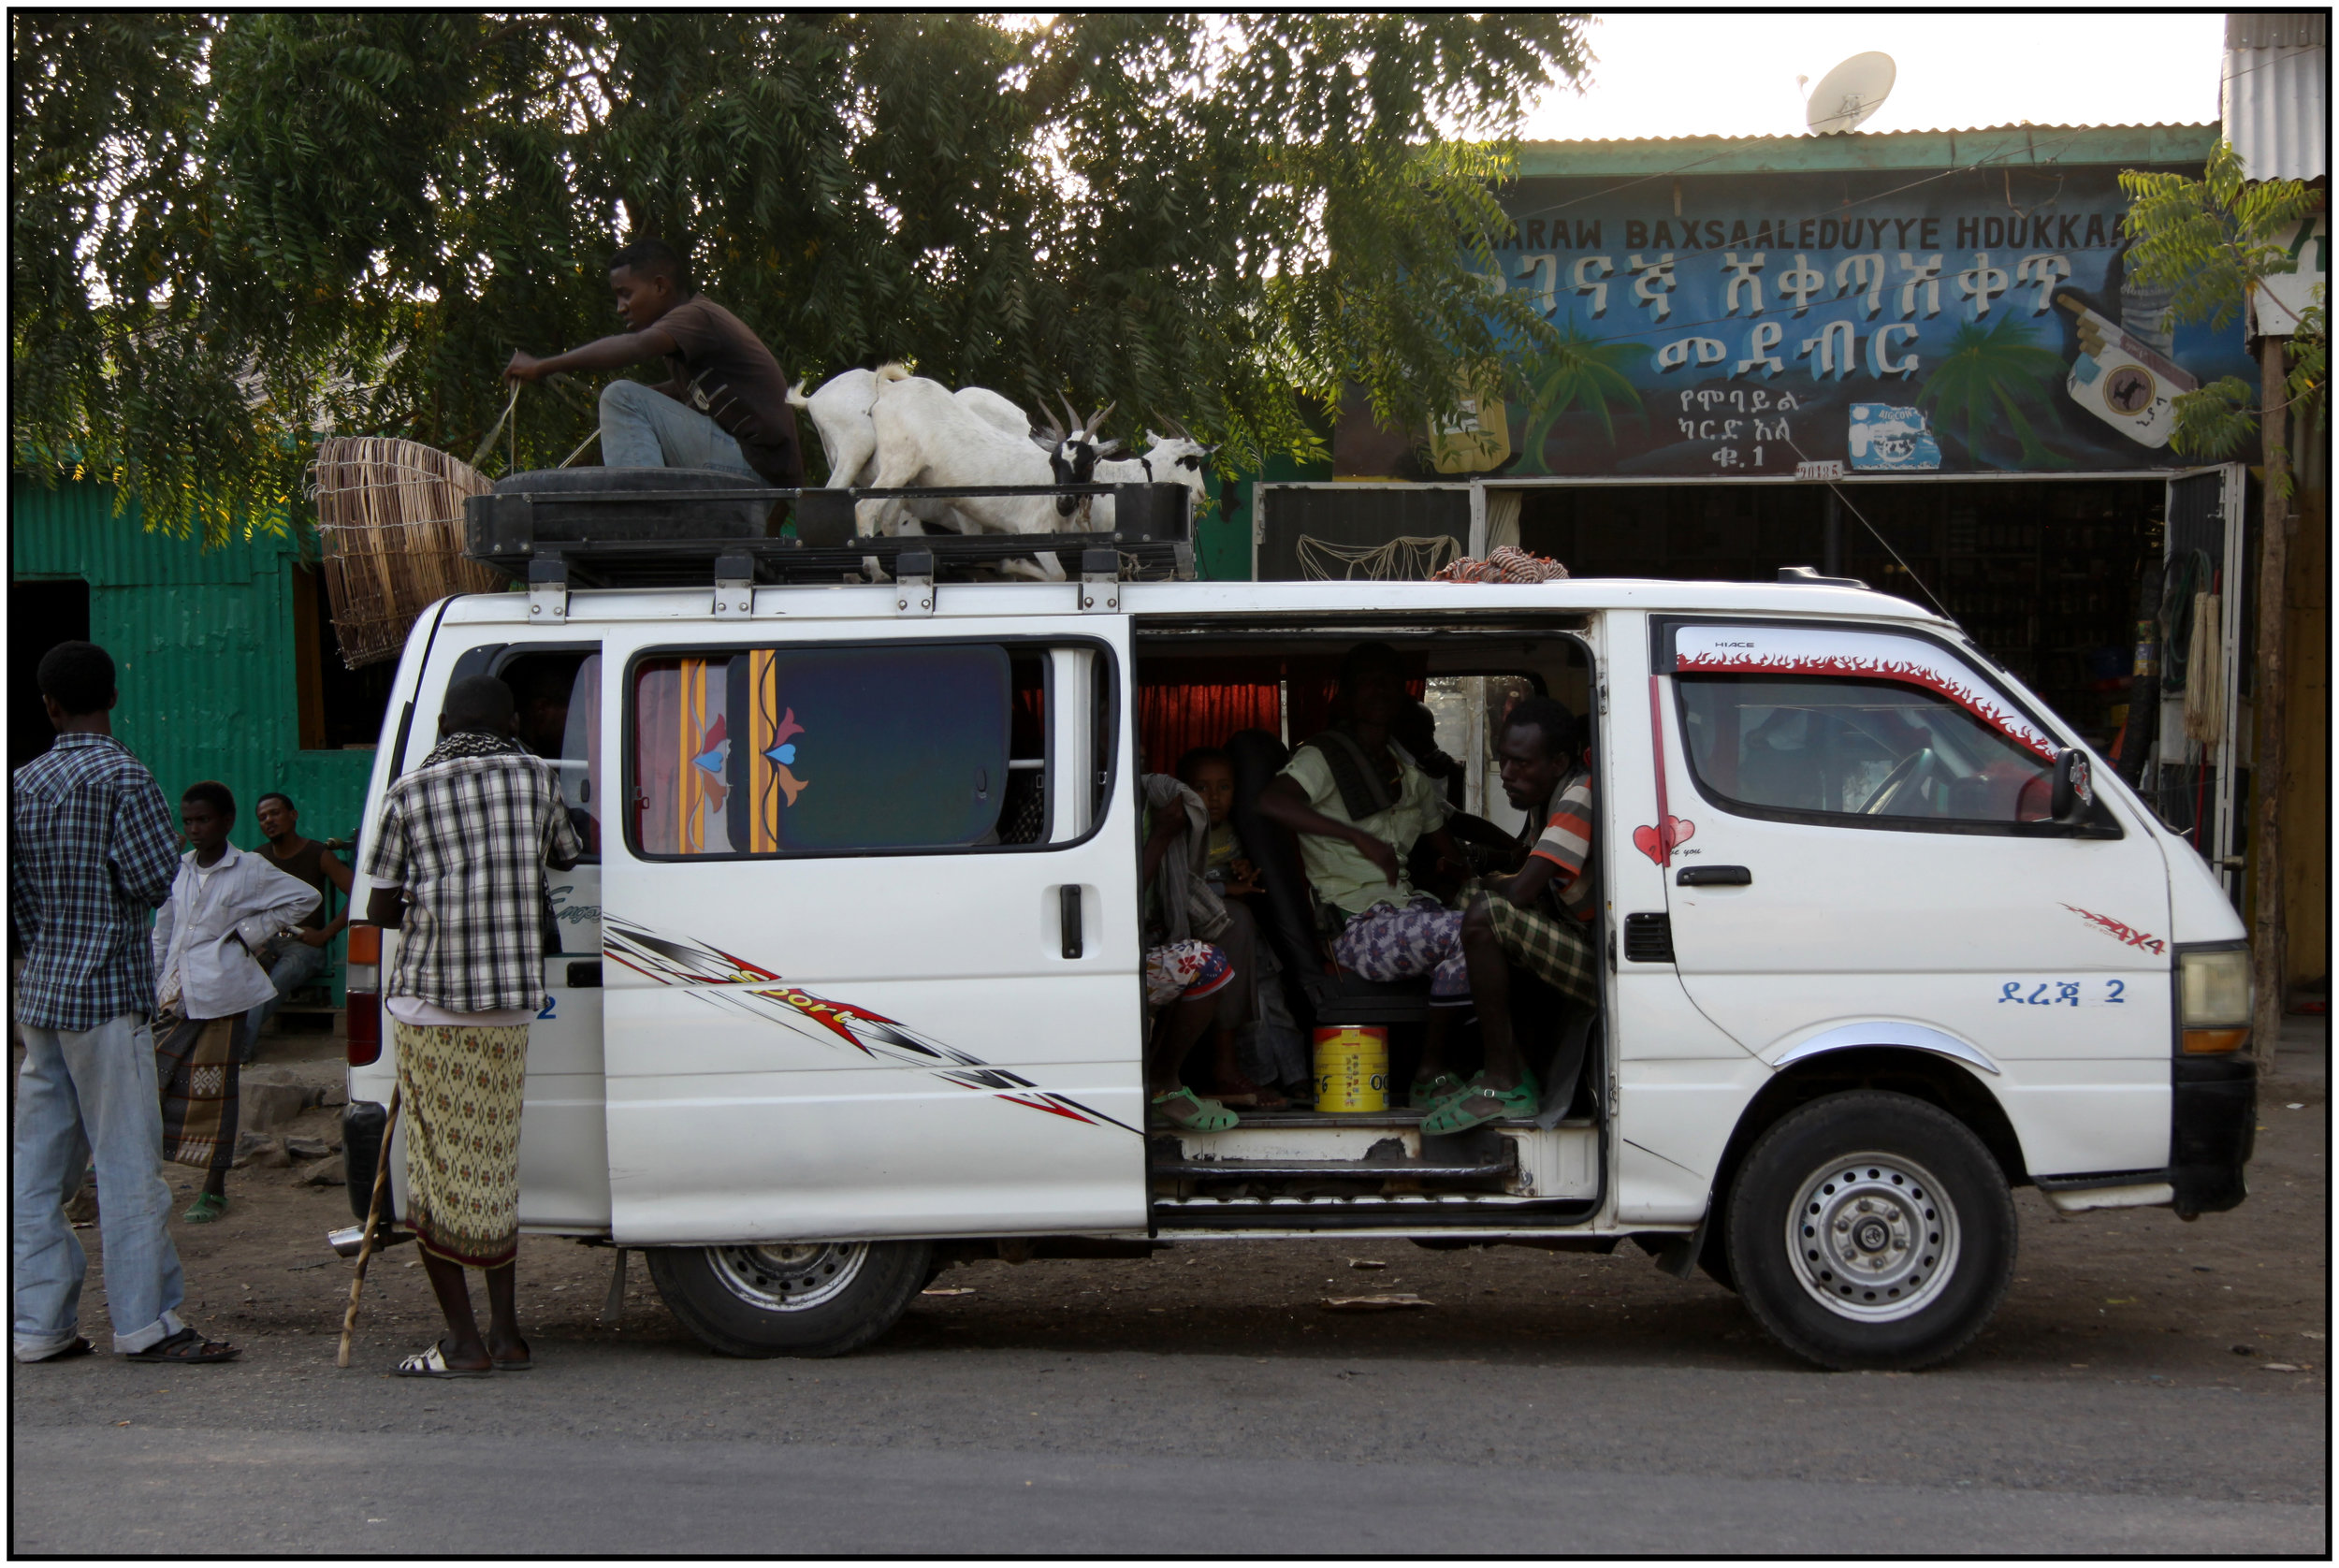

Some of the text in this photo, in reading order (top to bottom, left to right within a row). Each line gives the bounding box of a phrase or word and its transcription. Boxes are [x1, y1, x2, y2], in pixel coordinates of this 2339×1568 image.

[1626, 217, 1940, 250] BAXSAALEDUYYE
[1654, 319, 1920, 377] መደብር
[1679, 389, 1799, 414] የሞባይል
[1878, 409, 1894, 420] BIG
[1678, 417, 1744, 441] ካርድ
[1683, 848, 1701, 857] you
[1998, 979, 2125, 1007] ደረጃ 2
[536, 995, 557, 1020] 2
